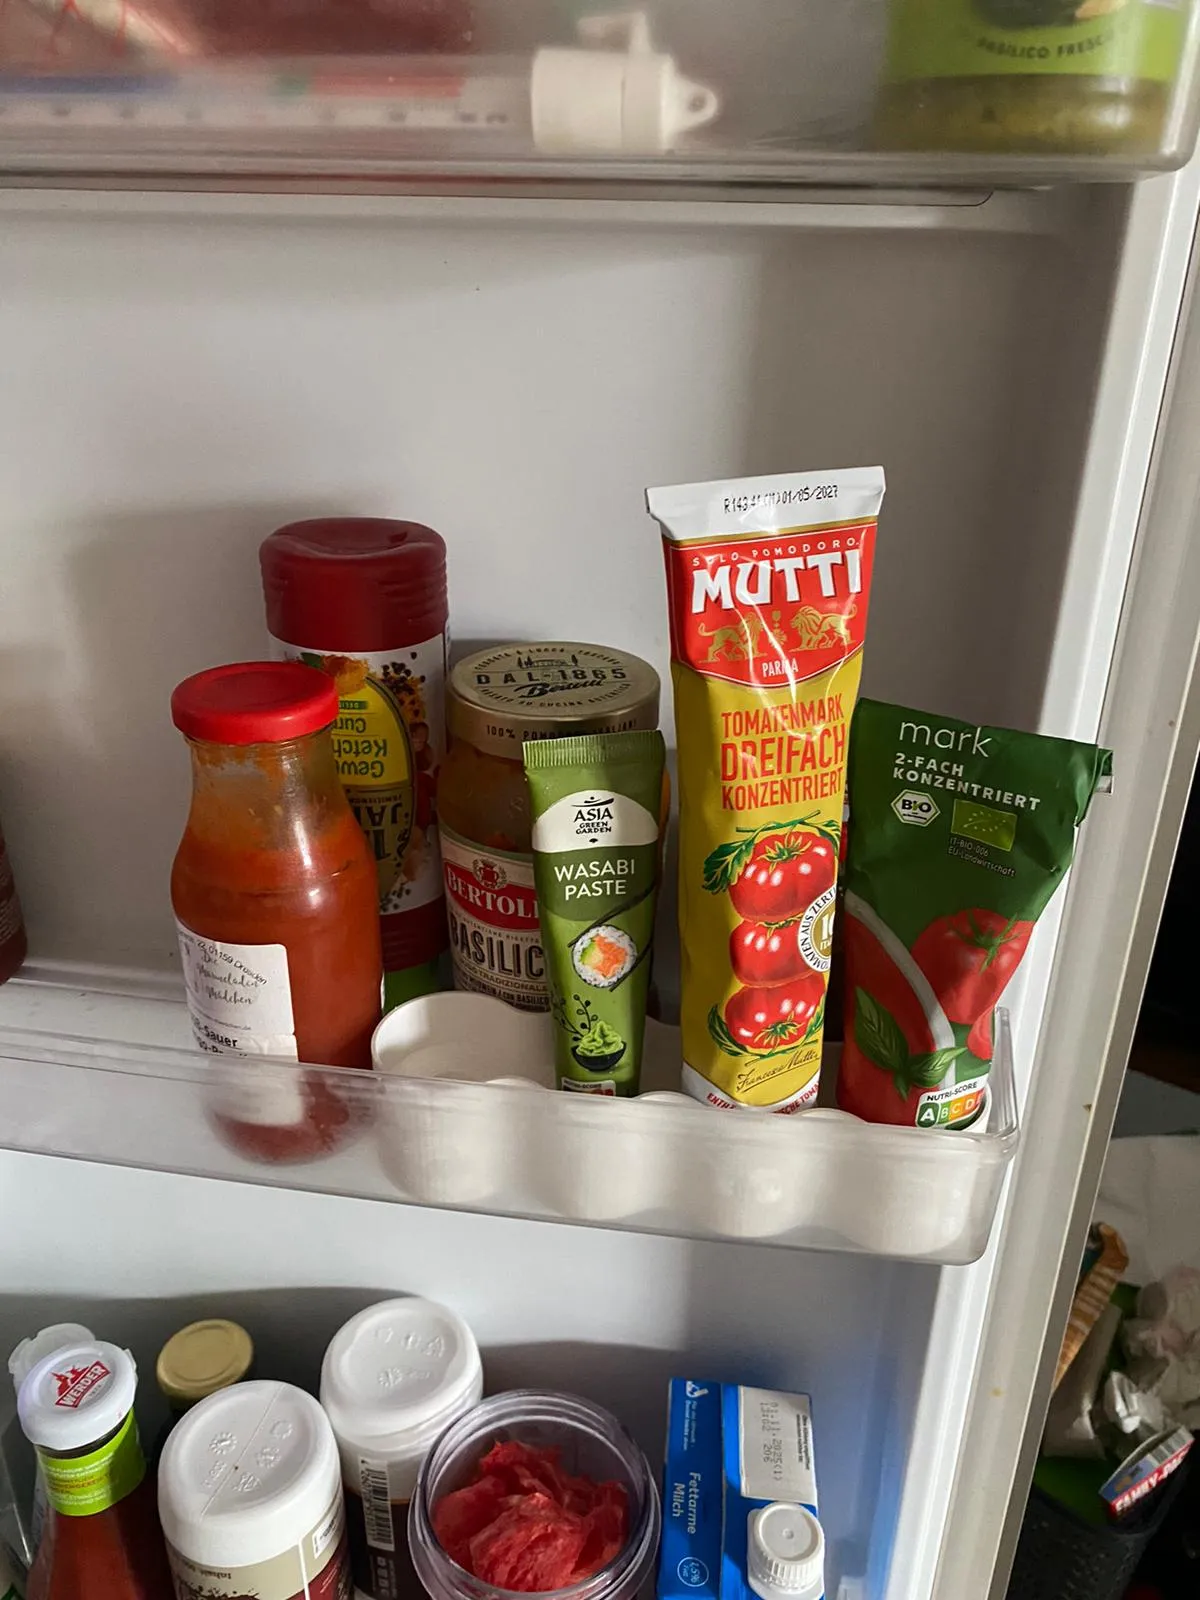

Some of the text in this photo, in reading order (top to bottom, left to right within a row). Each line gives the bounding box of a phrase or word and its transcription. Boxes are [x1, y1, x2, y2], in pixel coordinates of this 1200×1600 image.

[691, 548, 862, 614] MUTTI
[762, 659, 799, 678] PARMA
[721, 693, 844, 738] TOMATENMARK
[486, 725, 515, 739] 100%
[898, 720, 992, 758] mark
[721, 723, 846, 781] DREIFACH
[895, 752, 965, 777] 2-FACH
[721, 767, 844, 812] KONZENTRIERT
[893, 767, 1041, 811] KONZENTRIERT
[574, 807, 614, 823] ASIA
[579, 821, 609, 829] GREEN
[575, 826, 612, 835] GARDEN
[554, 859, 636, 882] WASABI
[565, 879, 627, 901] PASTE
[801, 915, 814, 936] AUS
[450, 911, 545, 979] BASILIC
[926, 1081, 978, 1102] NUTRI-SCORE
[920, 1108, 935, 1122] A
[940, 1107, 948, 1119] B
[951, 1103, 961, 1114] C
[59, 1365, 106, 1407] WERDER
[672, 1483, 686, 1518] Milch
[687, 1472, 702, 1535] Fettarme
